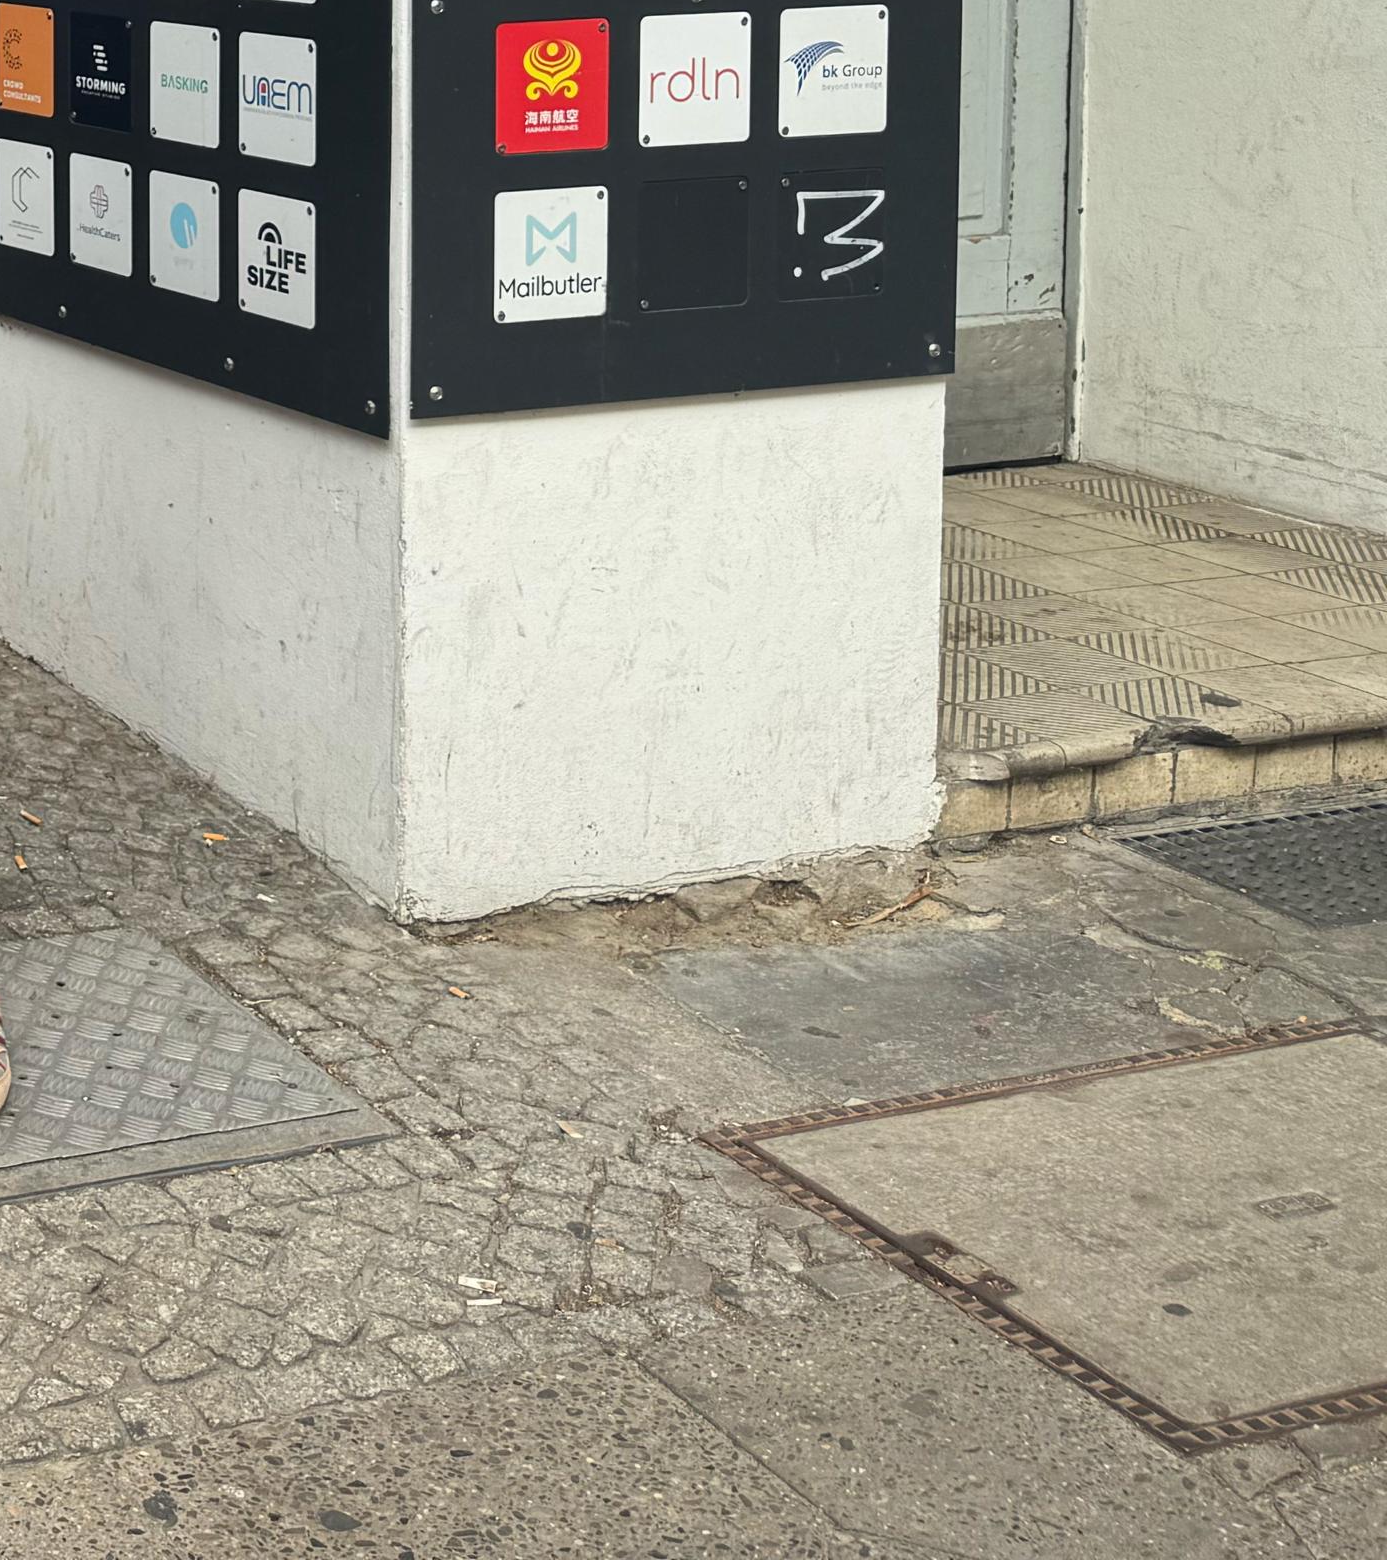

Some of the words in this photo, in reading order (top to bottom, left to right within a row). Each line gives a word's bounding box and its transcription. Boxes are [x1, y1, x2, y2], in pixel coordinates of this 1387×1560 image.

[648, 56, 741, 104] rdln
[823, 65, 838, 77] bk
[843, 64, 882, 78] Group
[74, 75, 127, 97] STORMING
[159, 73, 209, 95] BASKING
[523, 108, 580, 125] 海南航空
[265, 244, 308, 275] LIFE
[246, 265, 290, 295] SIZE
[497, 271, 602, 300] Mailbutler
